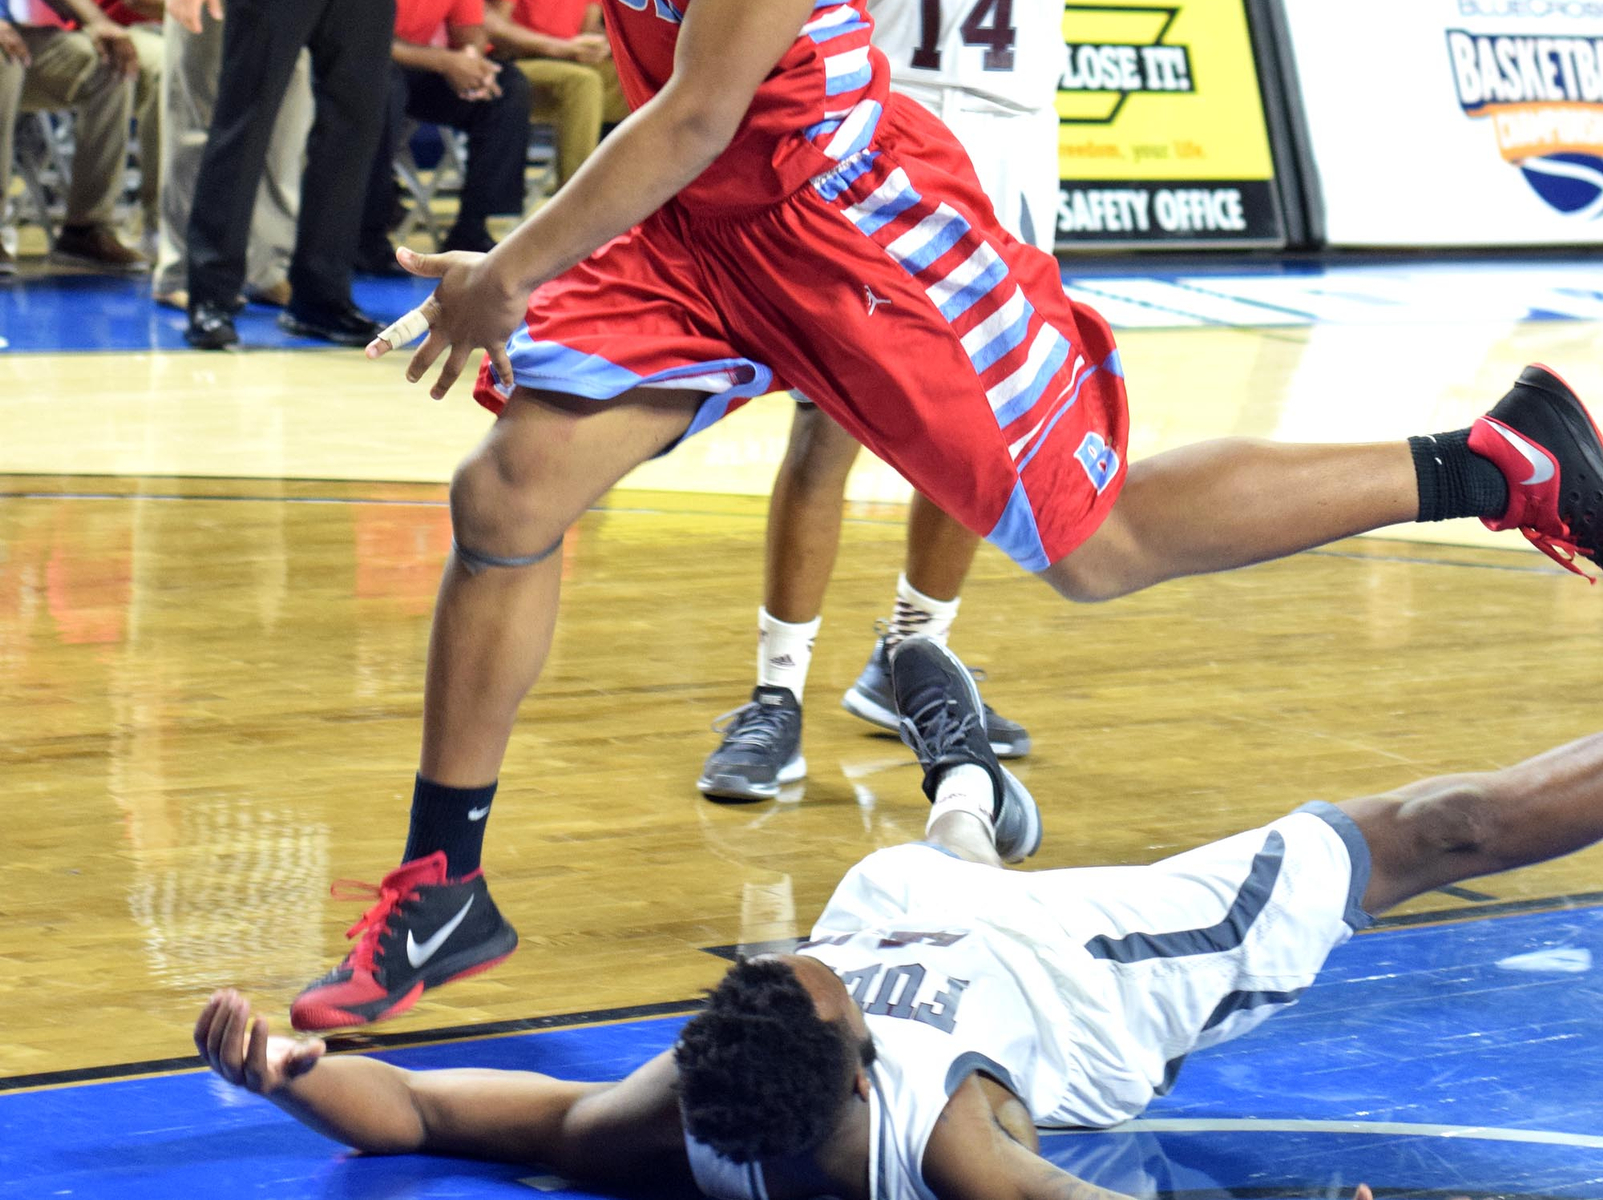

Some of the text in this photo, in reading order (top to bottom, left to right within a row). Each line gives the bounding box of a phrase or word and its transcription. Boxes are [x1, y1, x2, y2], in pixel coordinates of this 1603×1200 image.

[1141, 46, 1191, 91] IT!
[1058, 188, 1247, 232] SAFETY OFFICE
[1073, 430, 1120, 497] B
[830, 962, 970, 1036] FUL
